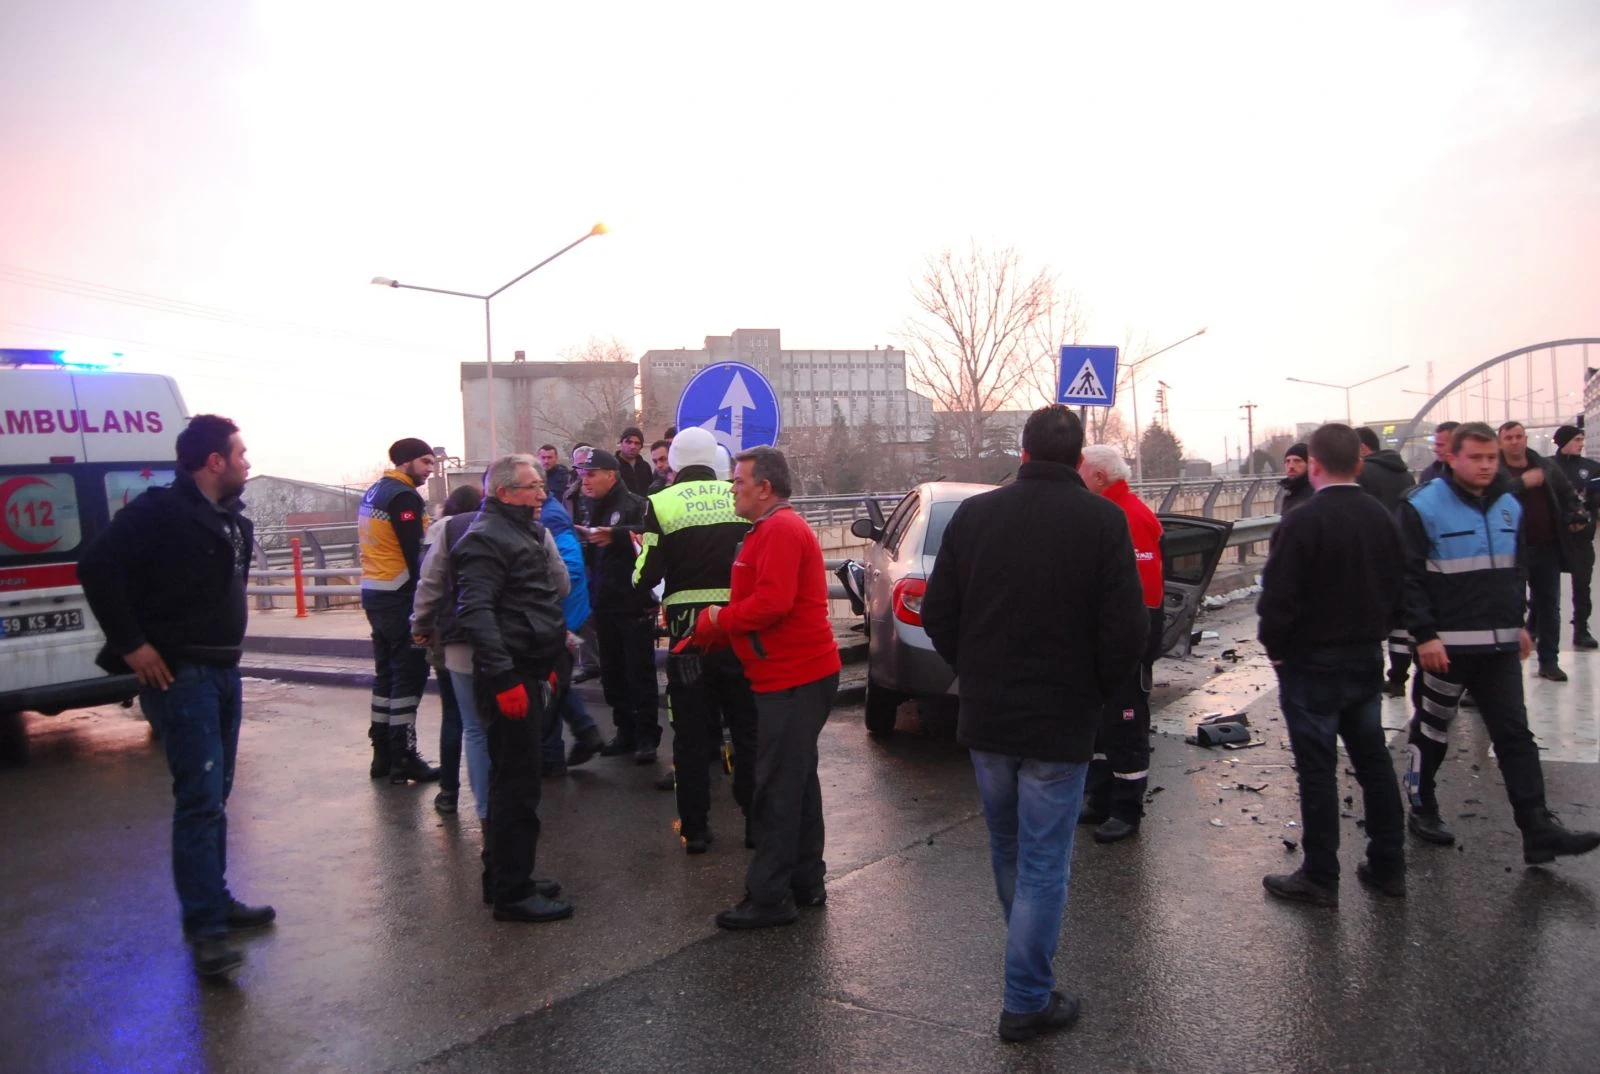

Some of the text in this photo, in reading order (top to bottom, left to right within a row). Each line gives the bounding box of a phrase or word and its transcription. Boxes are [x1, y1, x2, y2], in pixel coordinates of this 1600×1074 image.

[0, 409, 163, 435] MBULANS
[8, 500, 55, 528] 112
[3, 618, 21, 632] 59
[28, 616, 47, 629] KS
[54, 611, 80, 627] 213
